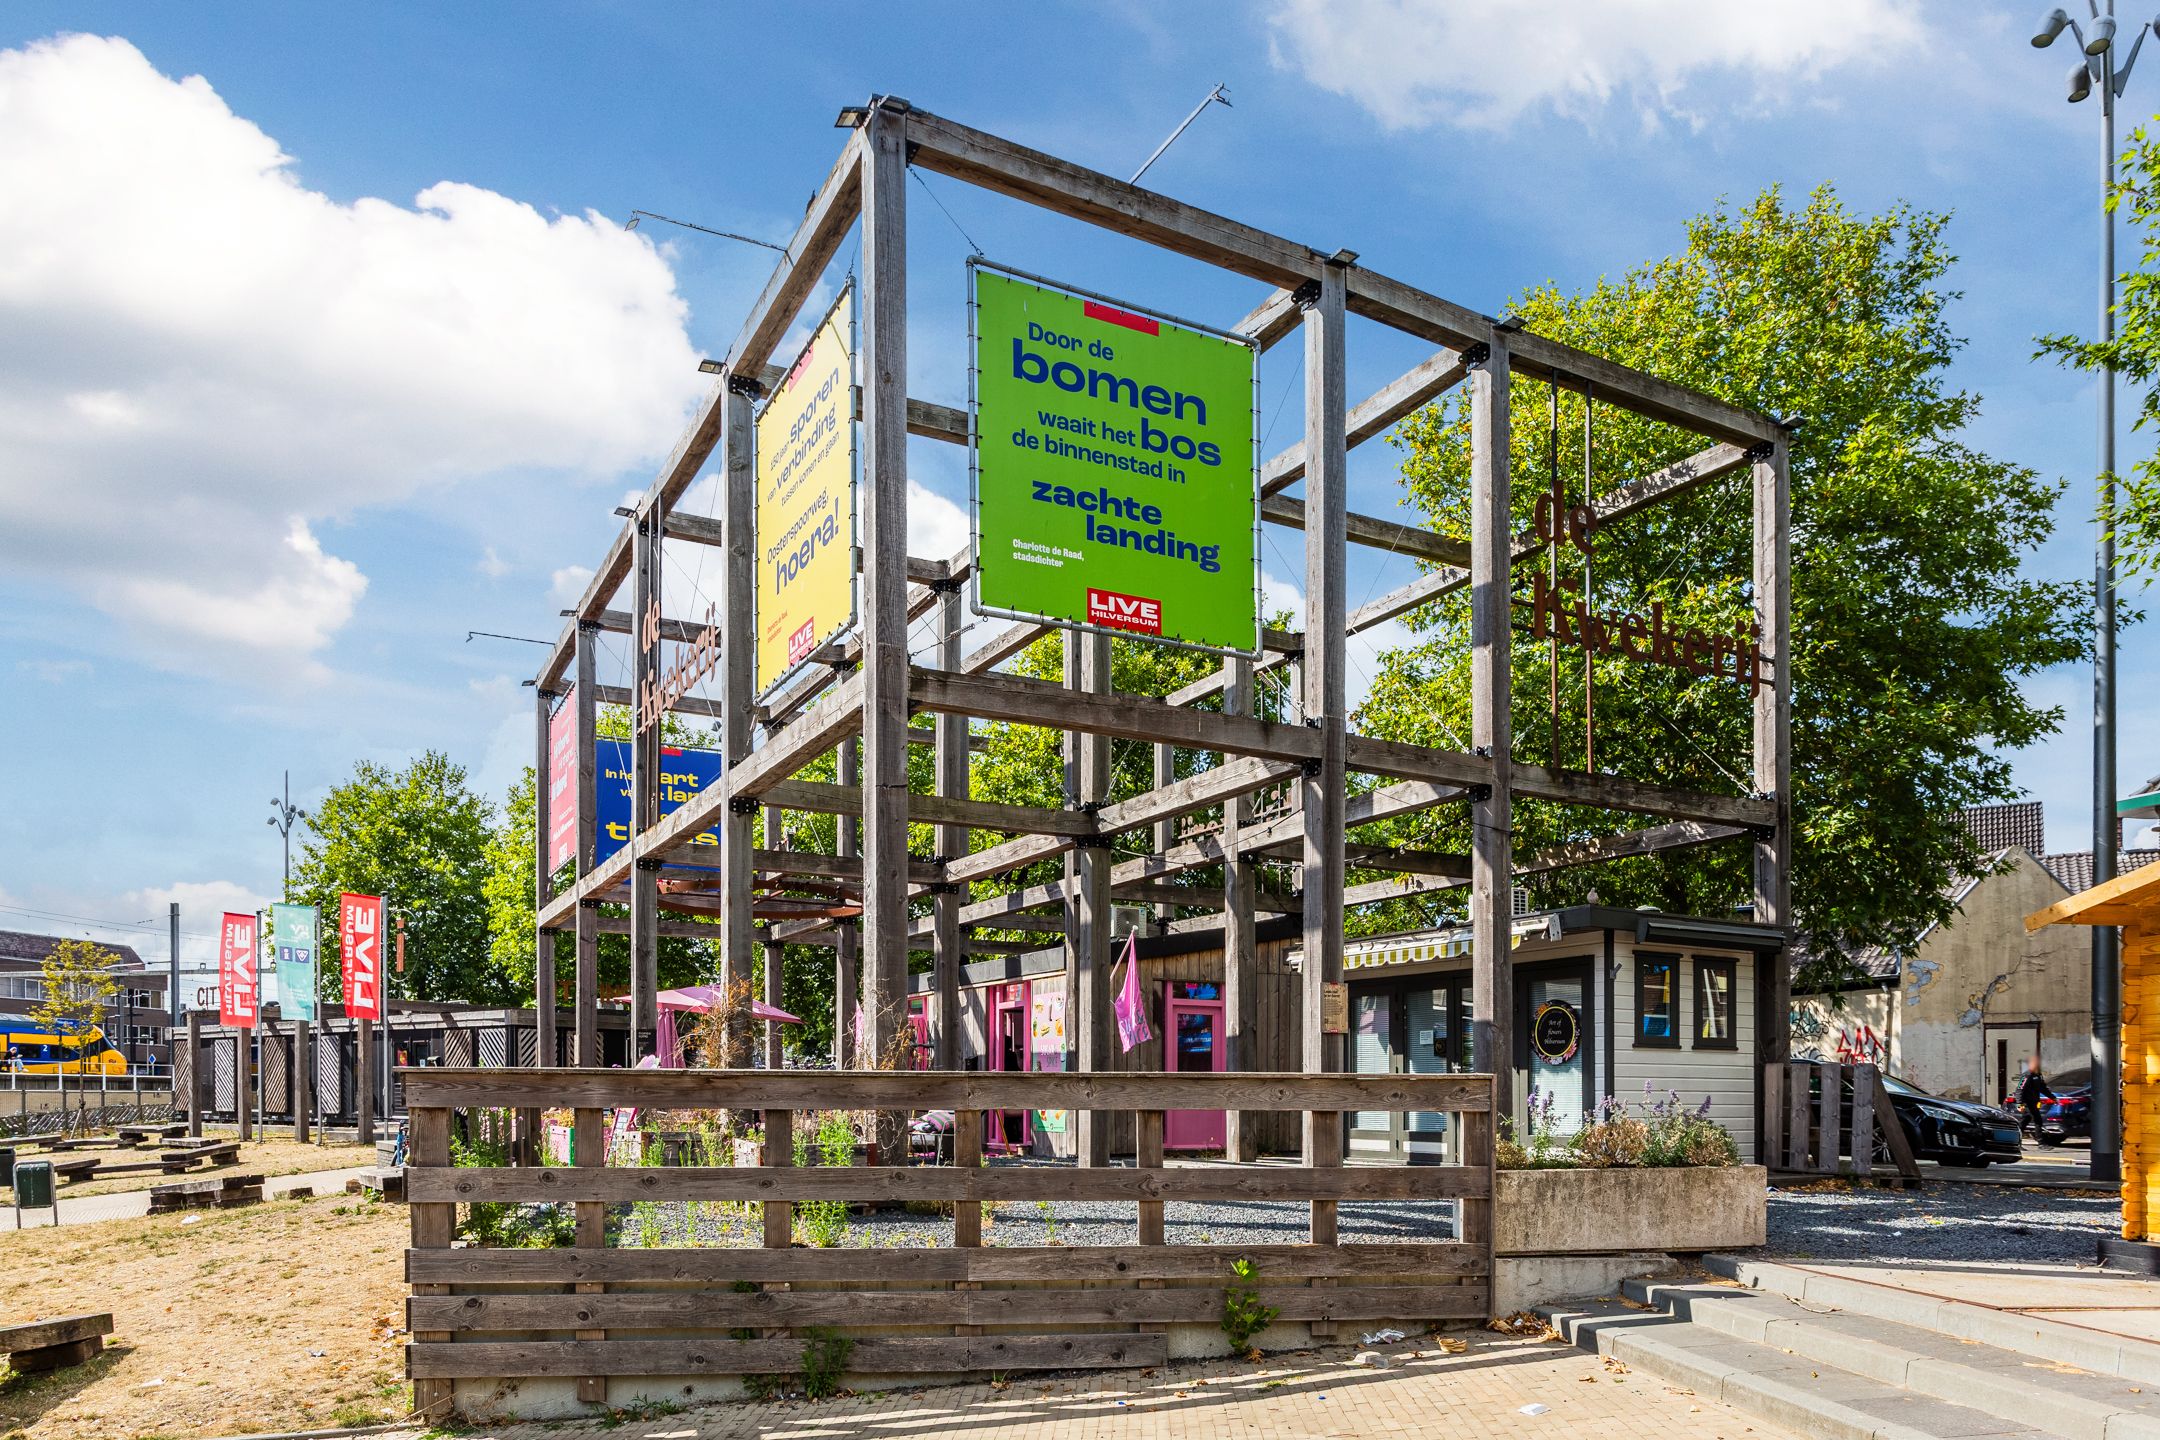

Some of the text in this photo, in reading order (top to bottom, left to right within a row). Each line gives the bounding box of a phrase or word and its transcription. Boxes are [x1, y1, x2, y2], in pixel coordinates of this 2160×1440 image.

[1028, 322, 1114, 361] Door de
[790, 368, 839, 444] sporen
[1012, 338, 1207, 426] bomen
[768, 402, 836, 502] van verbinding
[1012, 428, 1186, 484] de binnenstad in
[1037, 410, 1222, 466] waait het bos
[782, 480, 798, 507] tussen
[799, 459, 816, 484] komen
[818, 448, 825, 464] en
[1031, 479, 1163, 526] zachte
[767, 486, 829, 565] Oosterspoorweg,
[1086, 514, 1221, 574] landing
[1534, 479, 1600, 554] de
[776, 496, 839, 595] hoera!
[1012, 538, 1084, 562] Charlotte de Raad,
[1012, 552, 1064, 568] stadsdichter
[642, 592, 661, 655] de
[1091, 593, 1158, 620] LIVE
[1091, 610, 1158, 627] HILVERSUM
[790, 621, 813, 654] LIVE
[1533, 571, 1761, 699] Kwekerij
[641, 601, 716, 734] Kwekerij
[606, 769, 698, 788] In he art
[668, 786, 701, 802] lan
[197, 986, 220, 1006] CIT
